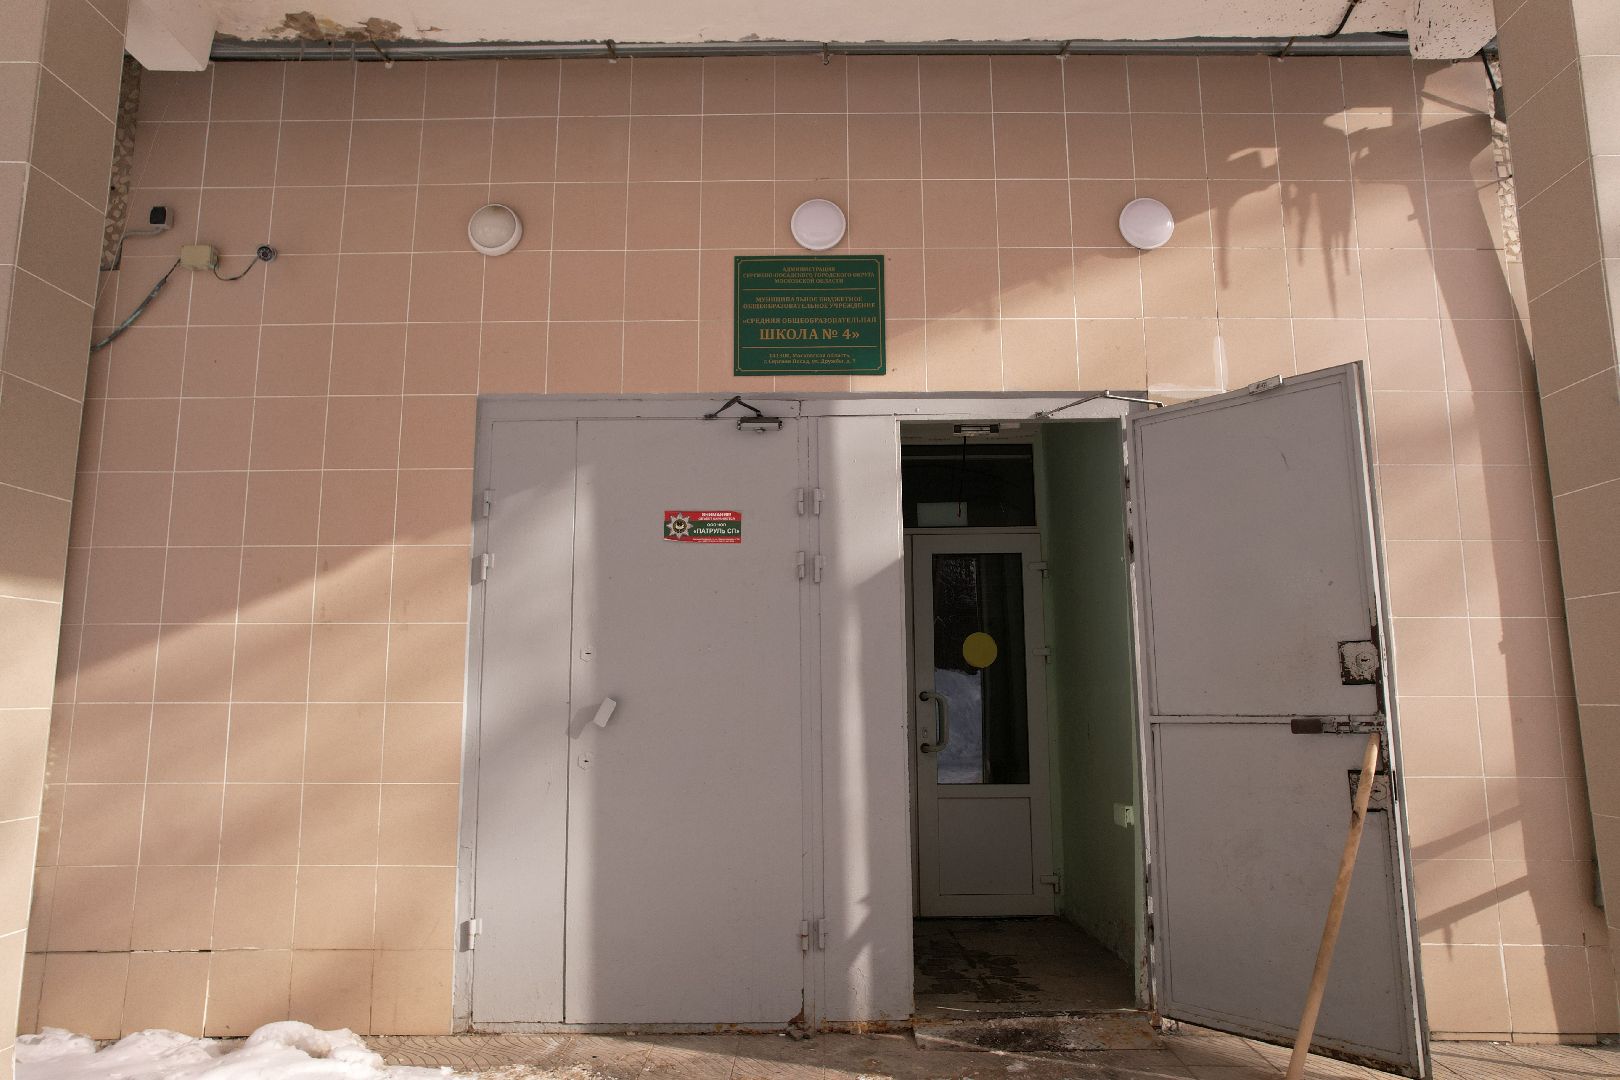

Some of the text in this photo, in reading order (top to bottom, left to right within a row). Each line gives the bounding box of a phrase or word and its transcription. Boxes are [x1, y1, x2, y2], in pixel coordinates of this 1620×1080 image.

[782, 316, 876, 324] ОБЩЕОБРАЗОВАТЕЛЬНАЯ
[759, 328, 860, 340] ШКОЛА № 4»
